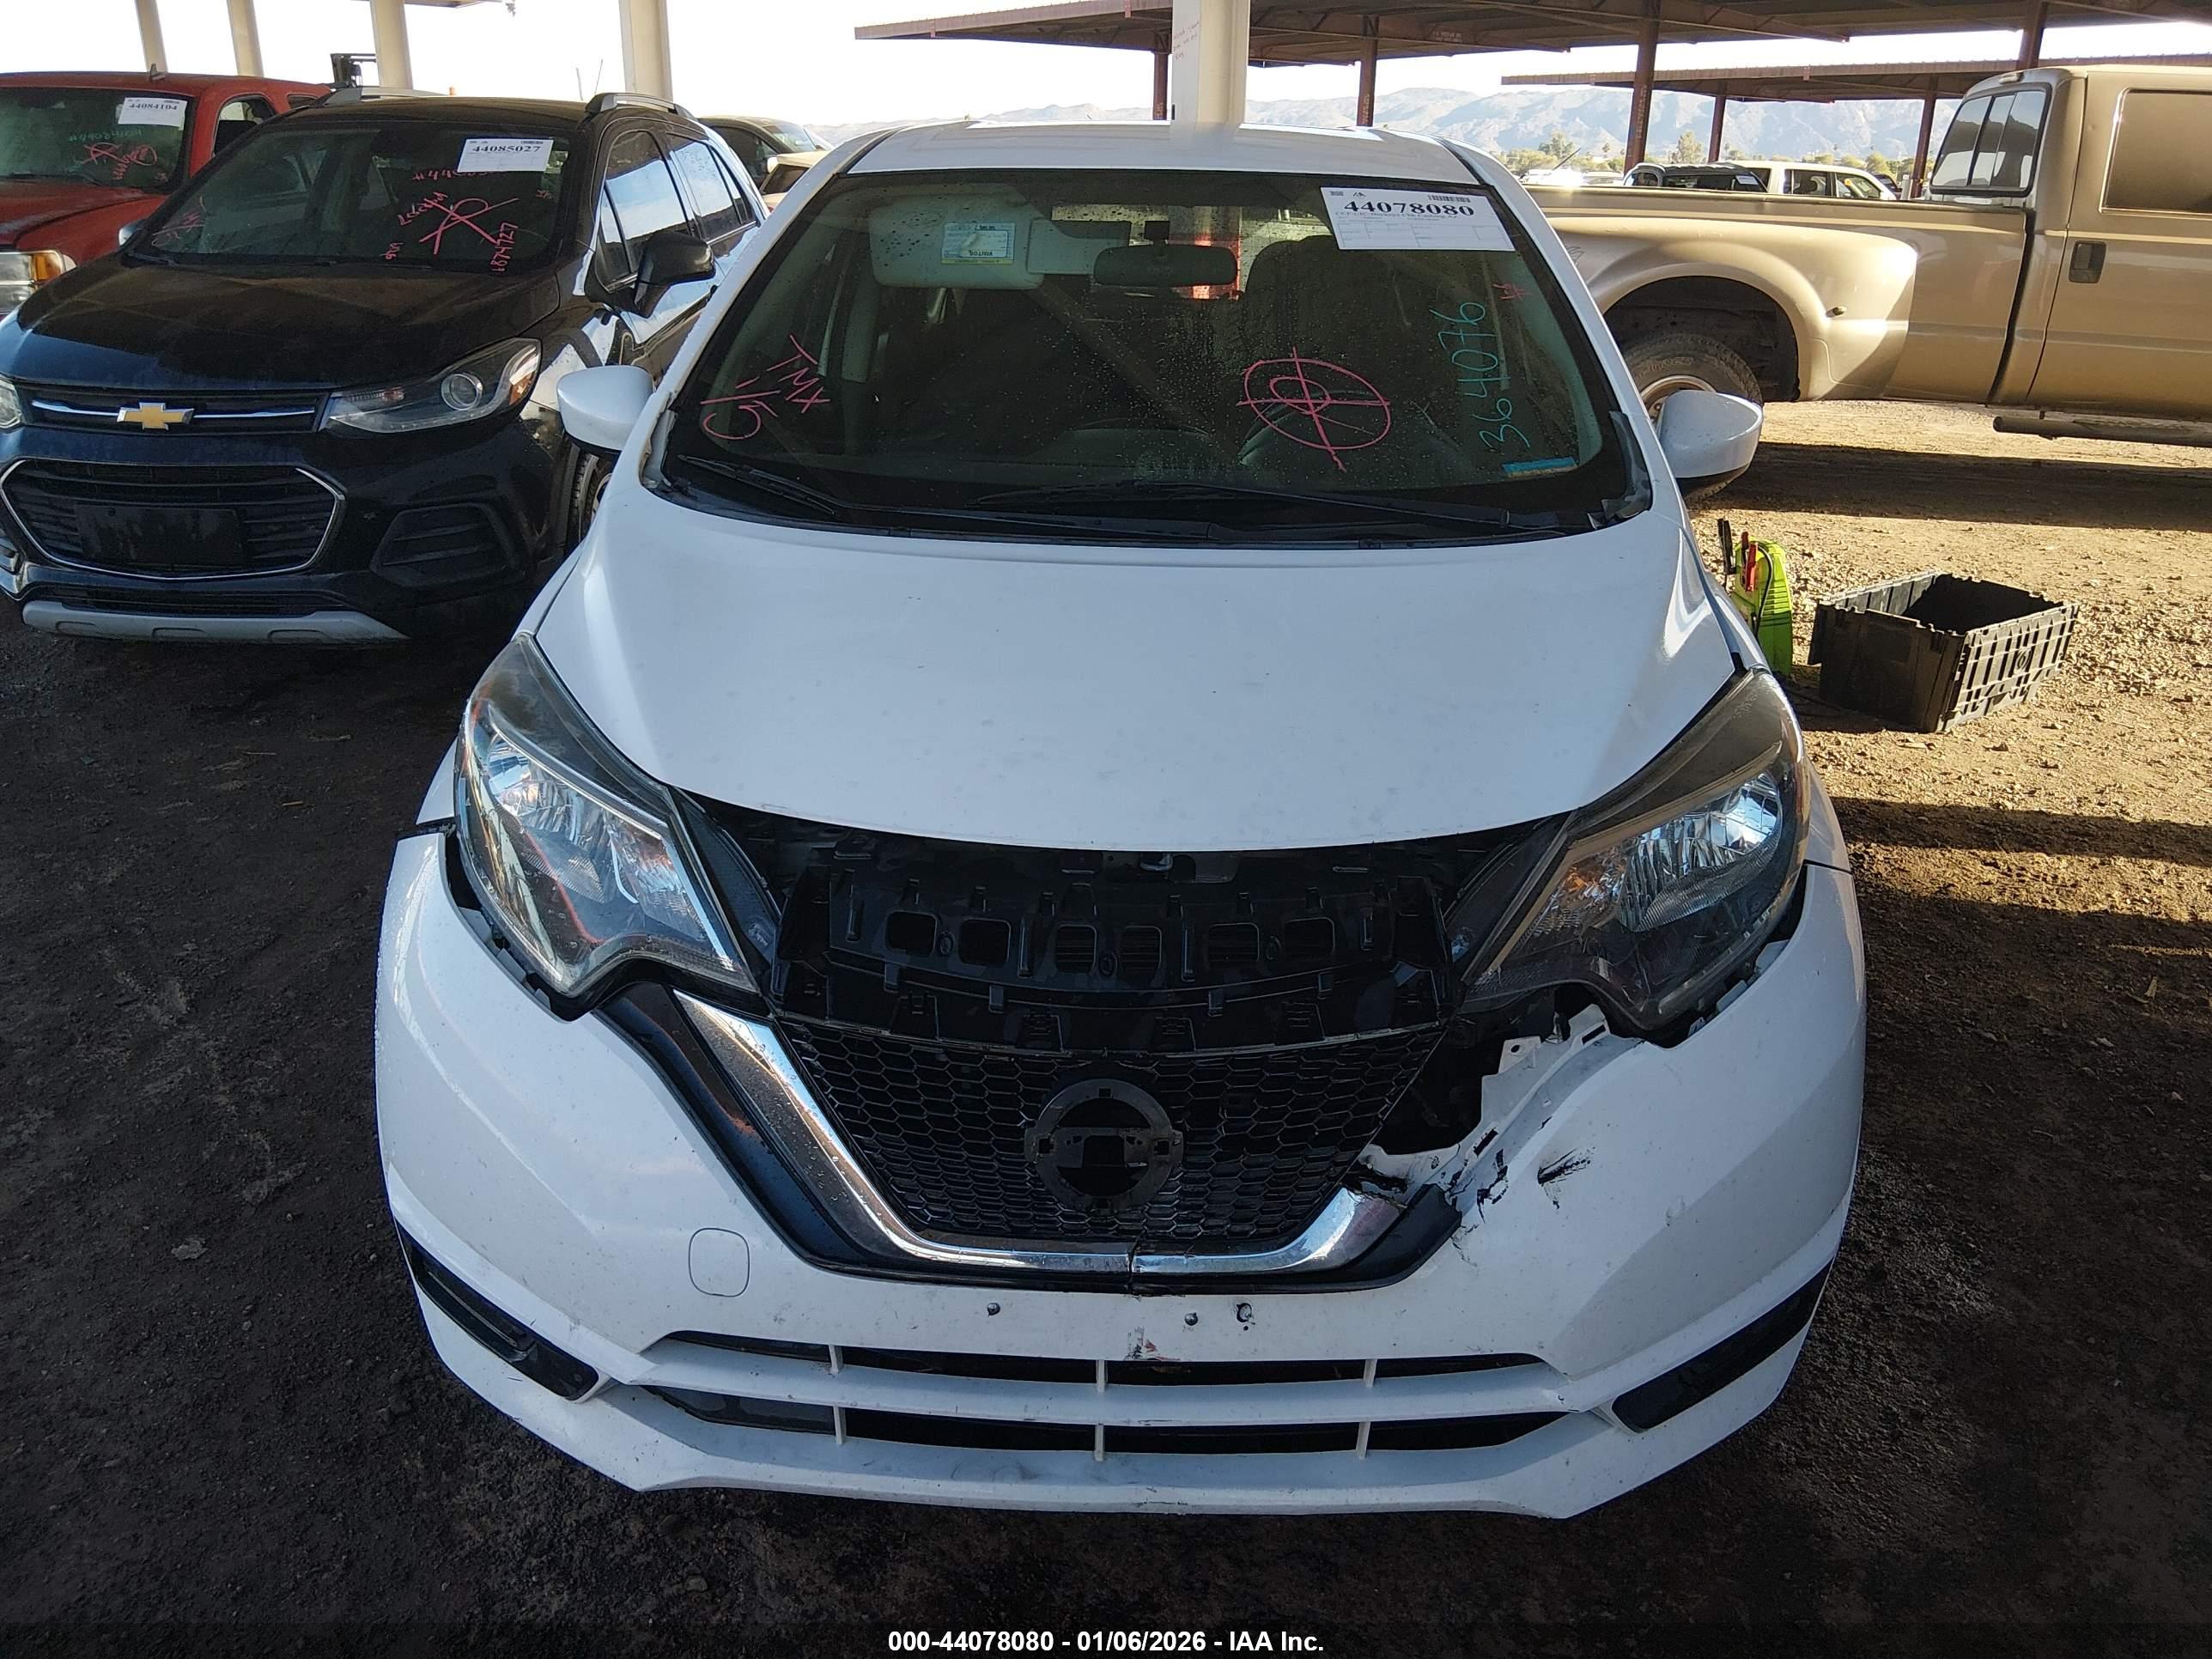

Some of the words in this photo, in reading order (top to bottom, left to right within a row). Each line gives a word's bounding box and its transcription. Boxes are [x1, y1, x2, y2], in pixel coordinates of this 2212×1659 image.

[129, 102, 178, 112] 44084104
[1344, 200, 1475, 216] 44078080
[1429, 301, 1531, 449] 364076
